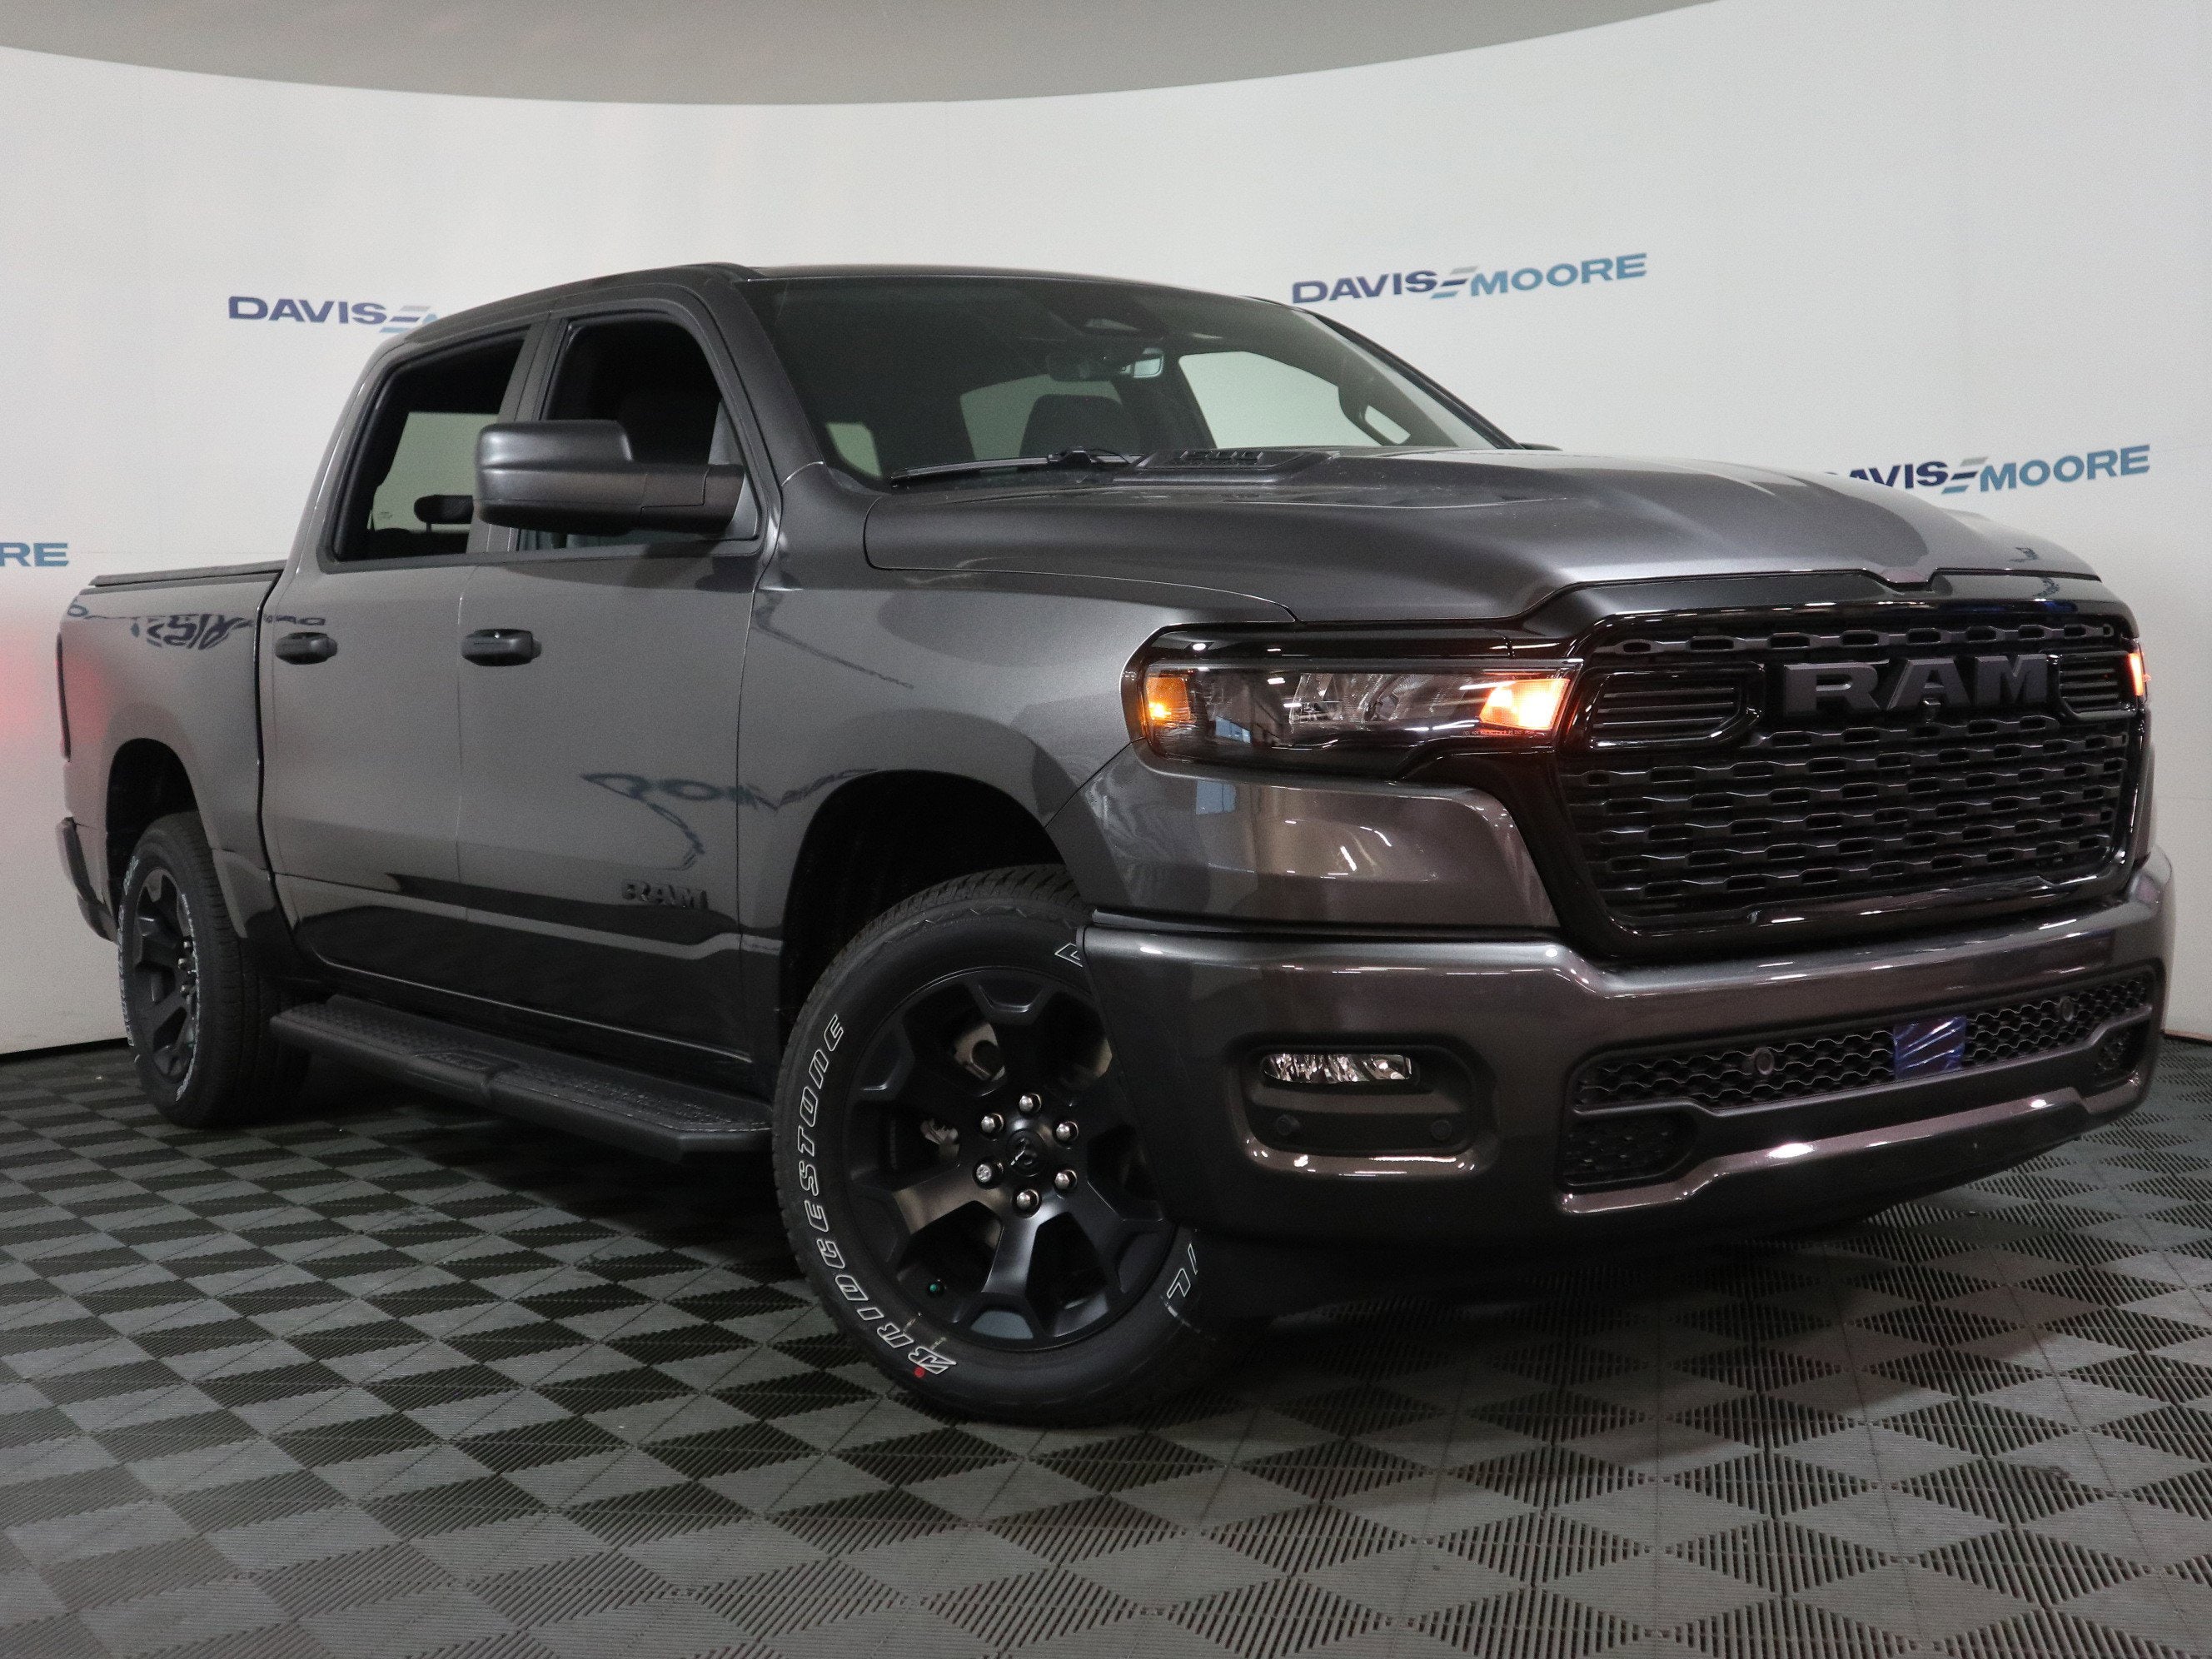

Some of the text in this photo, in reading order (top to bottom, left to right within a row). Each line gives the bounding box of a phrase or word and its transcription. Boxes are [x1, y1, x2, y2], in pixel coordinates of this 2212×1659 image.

[1293, 252, 1647, 303] DAVIS MOORE
[229, 296, 388, 325] DAVIS
[1825, 444, 2150, 492] VIS MOORE
[1783, 654, 2048, 714] RAM
[621, 879, 709, 910] RAM
[797, 1014, 957, 1375] BRIDGESTONE
